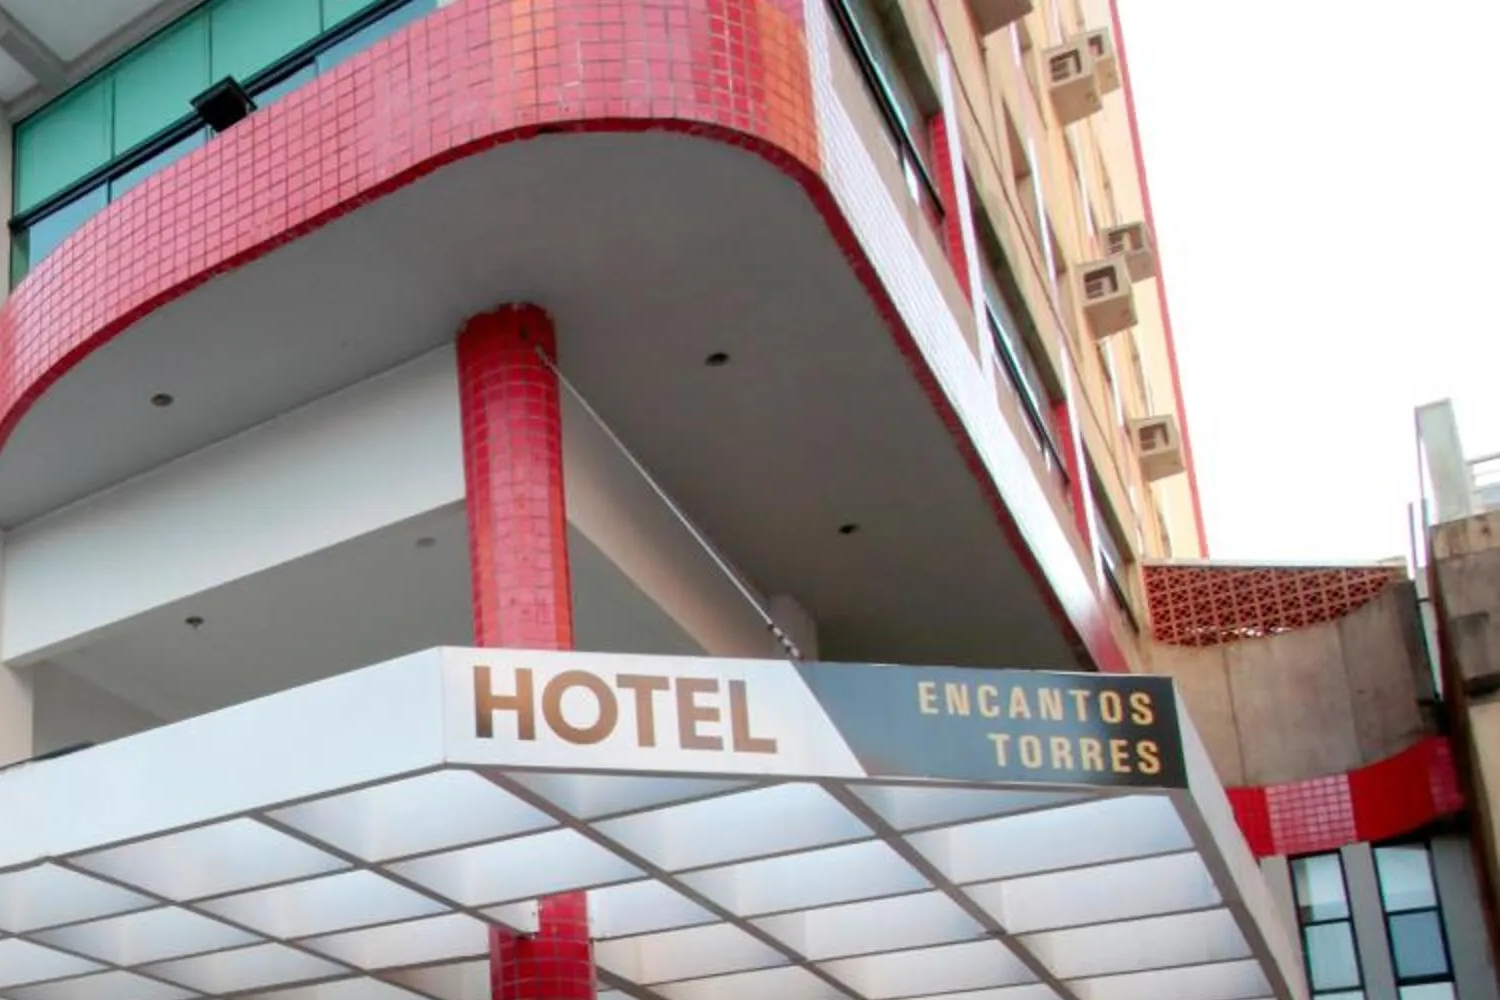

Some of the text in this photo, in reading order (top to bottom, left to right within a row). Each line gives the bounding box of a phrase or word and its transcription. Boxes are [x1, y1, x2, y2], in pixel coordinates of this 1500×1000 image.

[473, 664, 778, 754] HOTEL
[917, 680, 1155, 726] ENCANTOS
[987, 733, 1162, 775] TORRES
